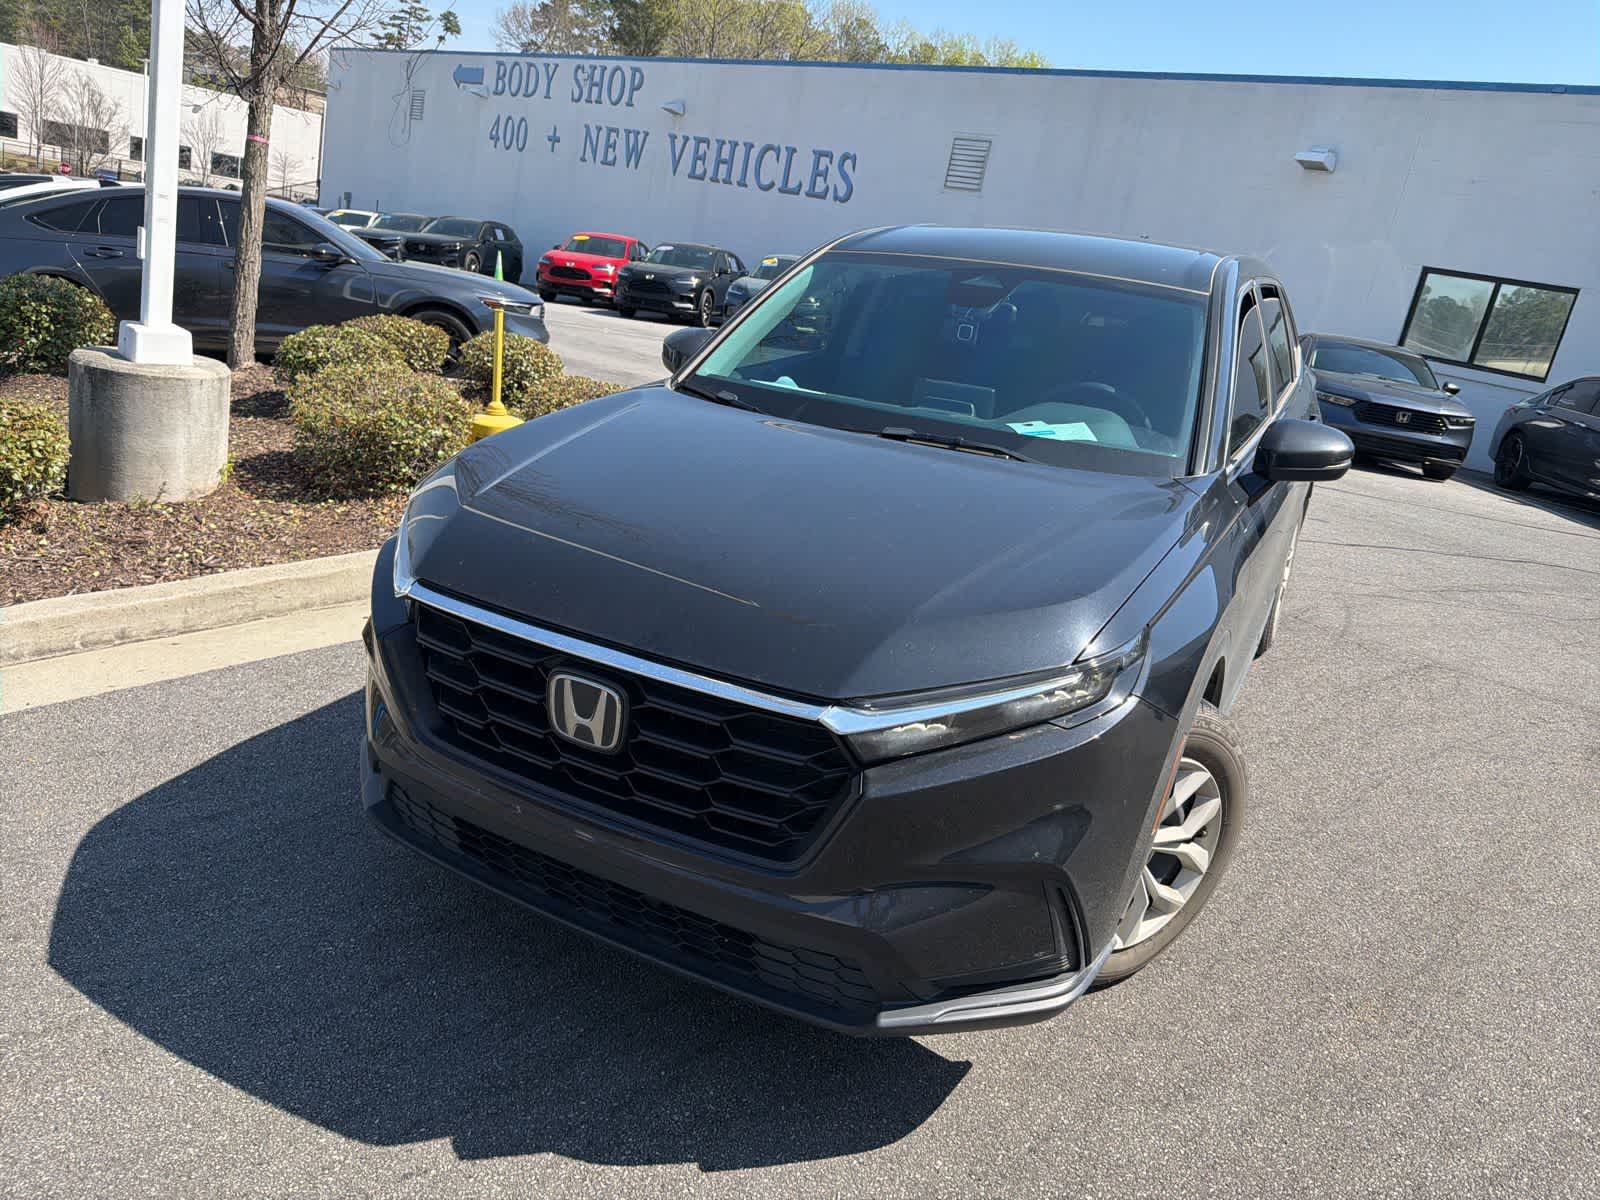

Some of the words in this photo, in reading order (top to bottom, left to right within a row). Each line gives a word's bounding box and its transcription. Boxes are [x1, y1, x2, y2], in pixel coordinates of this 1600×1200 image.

[493, 61, 559, 99] BODY
[570, 63, 645, 107] SHOP
[489, 115, 528, 152] 400
[547, 126, 561, 153] +
[579, 123, 649, 169] NEW
[668, 132, 857, 204] VEHICLES
